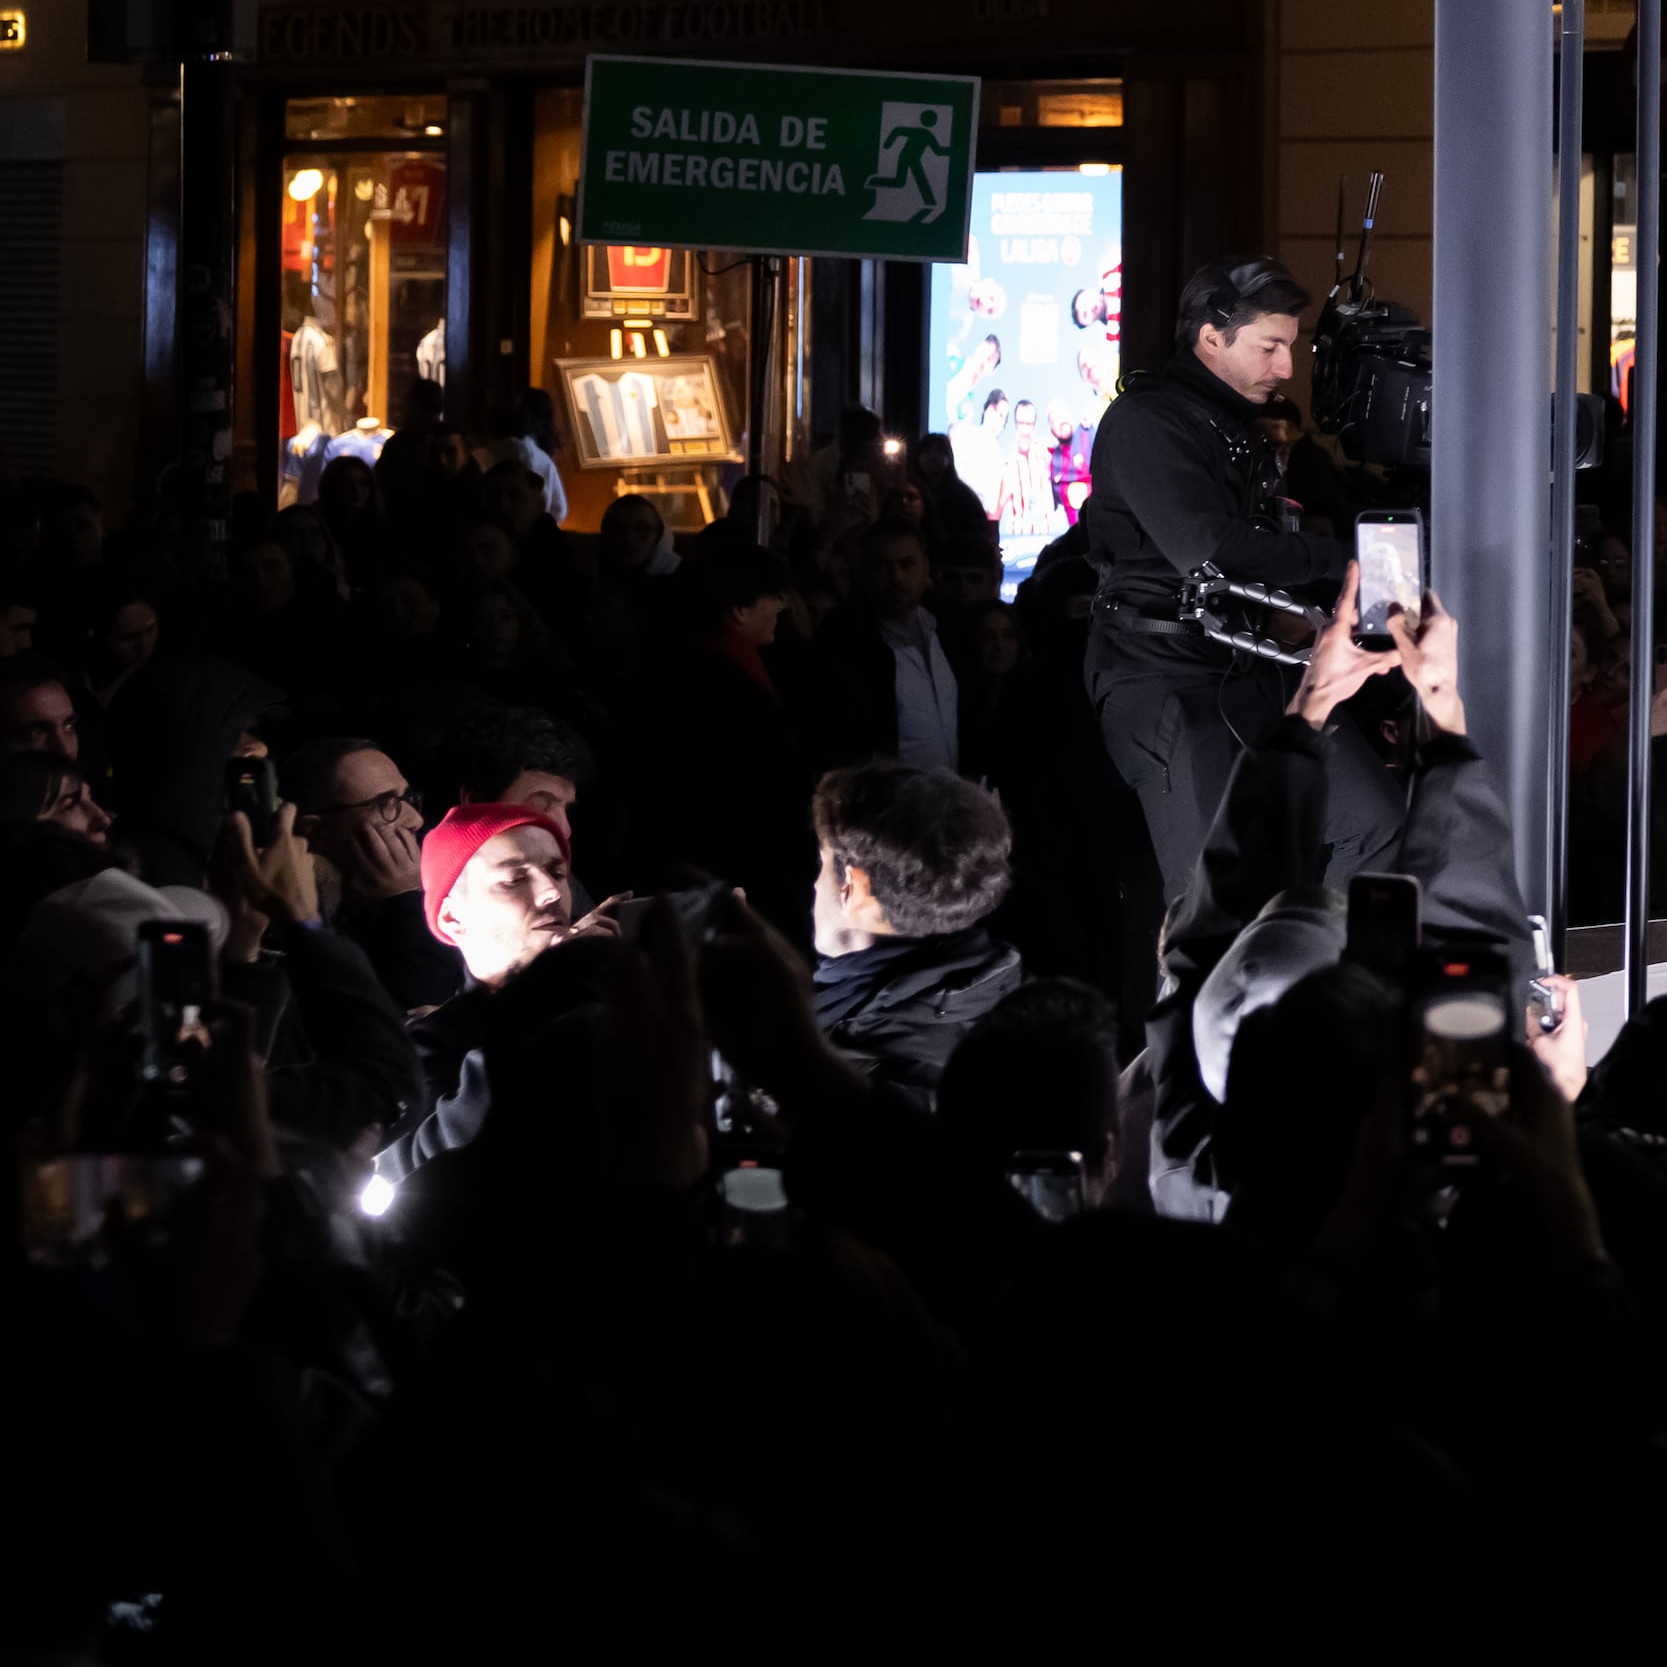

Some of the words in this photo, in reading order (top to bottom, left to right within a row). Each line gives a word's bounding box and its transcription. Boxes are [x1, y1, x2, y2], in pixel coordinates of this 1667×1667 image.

[263, 9, 420, 61] EGENDS
[630, 105, 761, 146] SALIDA
[779, 115, 828, 150] DE
[604, 148, 846, 197] EMERGENCIA
